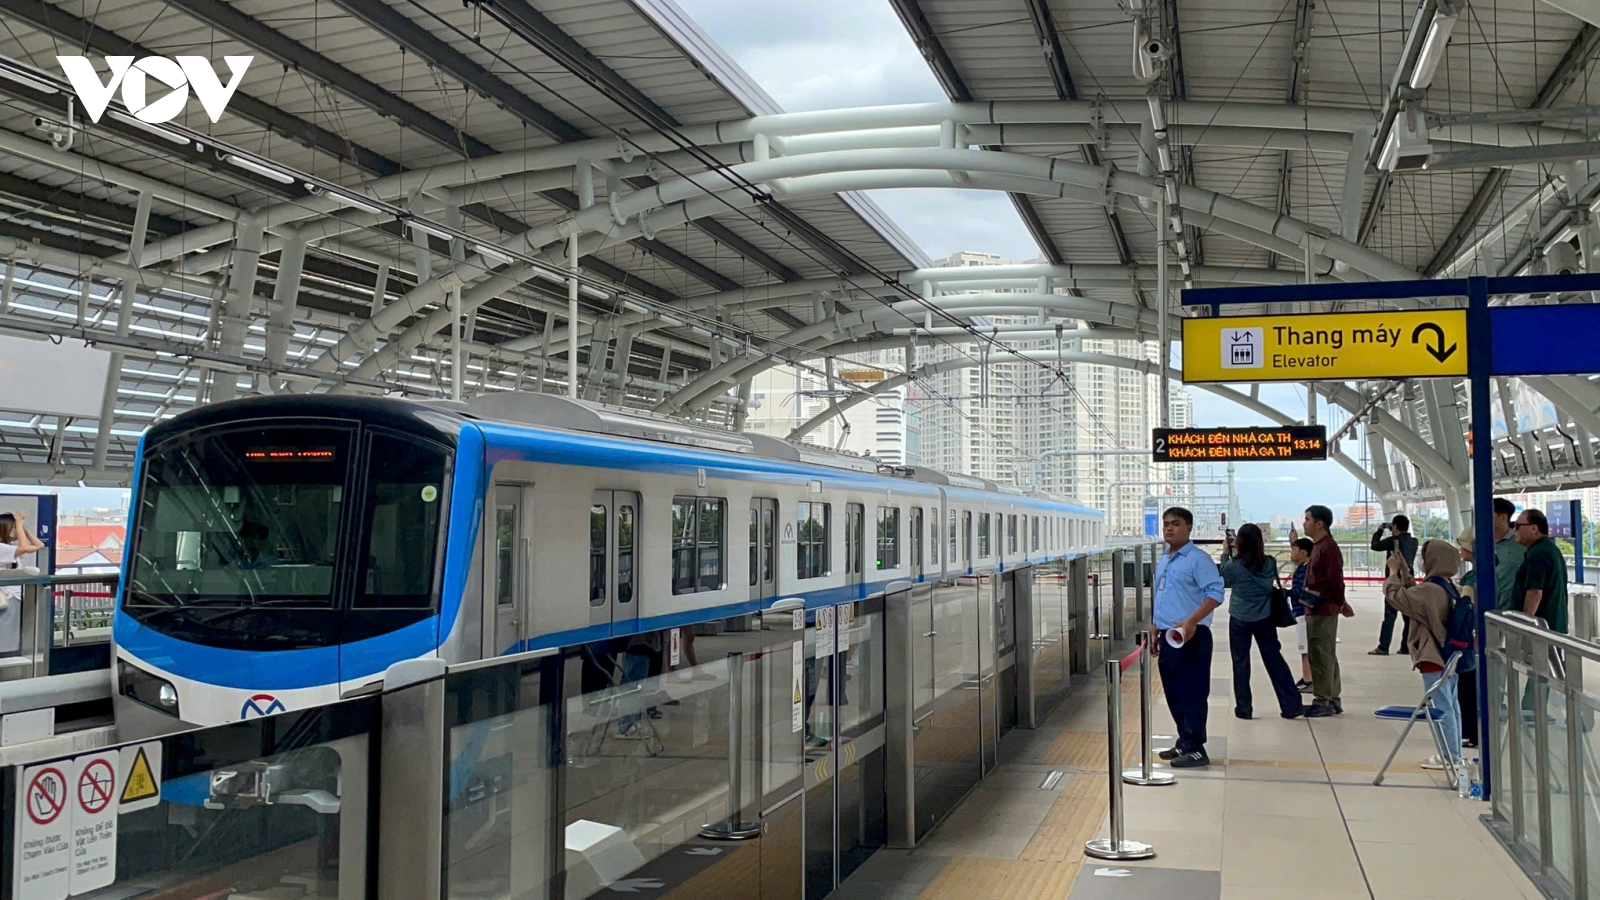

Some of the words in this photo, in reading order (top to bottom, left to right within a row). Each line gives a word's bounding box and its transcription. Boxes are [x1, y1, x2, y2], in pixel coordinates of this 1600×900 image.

[1272, 325, 1343, 349] Thang
[1352, 323, 1402, 347] máy
[1272, 353, 1338, 369] Elevator
[1258, 433, 1274, 443] GA
[1277, 433, 1291, 443] TH
[1293, 439, 1321, 449] 13:14
[1155, 438, 1165, 453] 2
[1258, 447, 1276, 457] GA
[1277, 446, 1292, 456] TH
